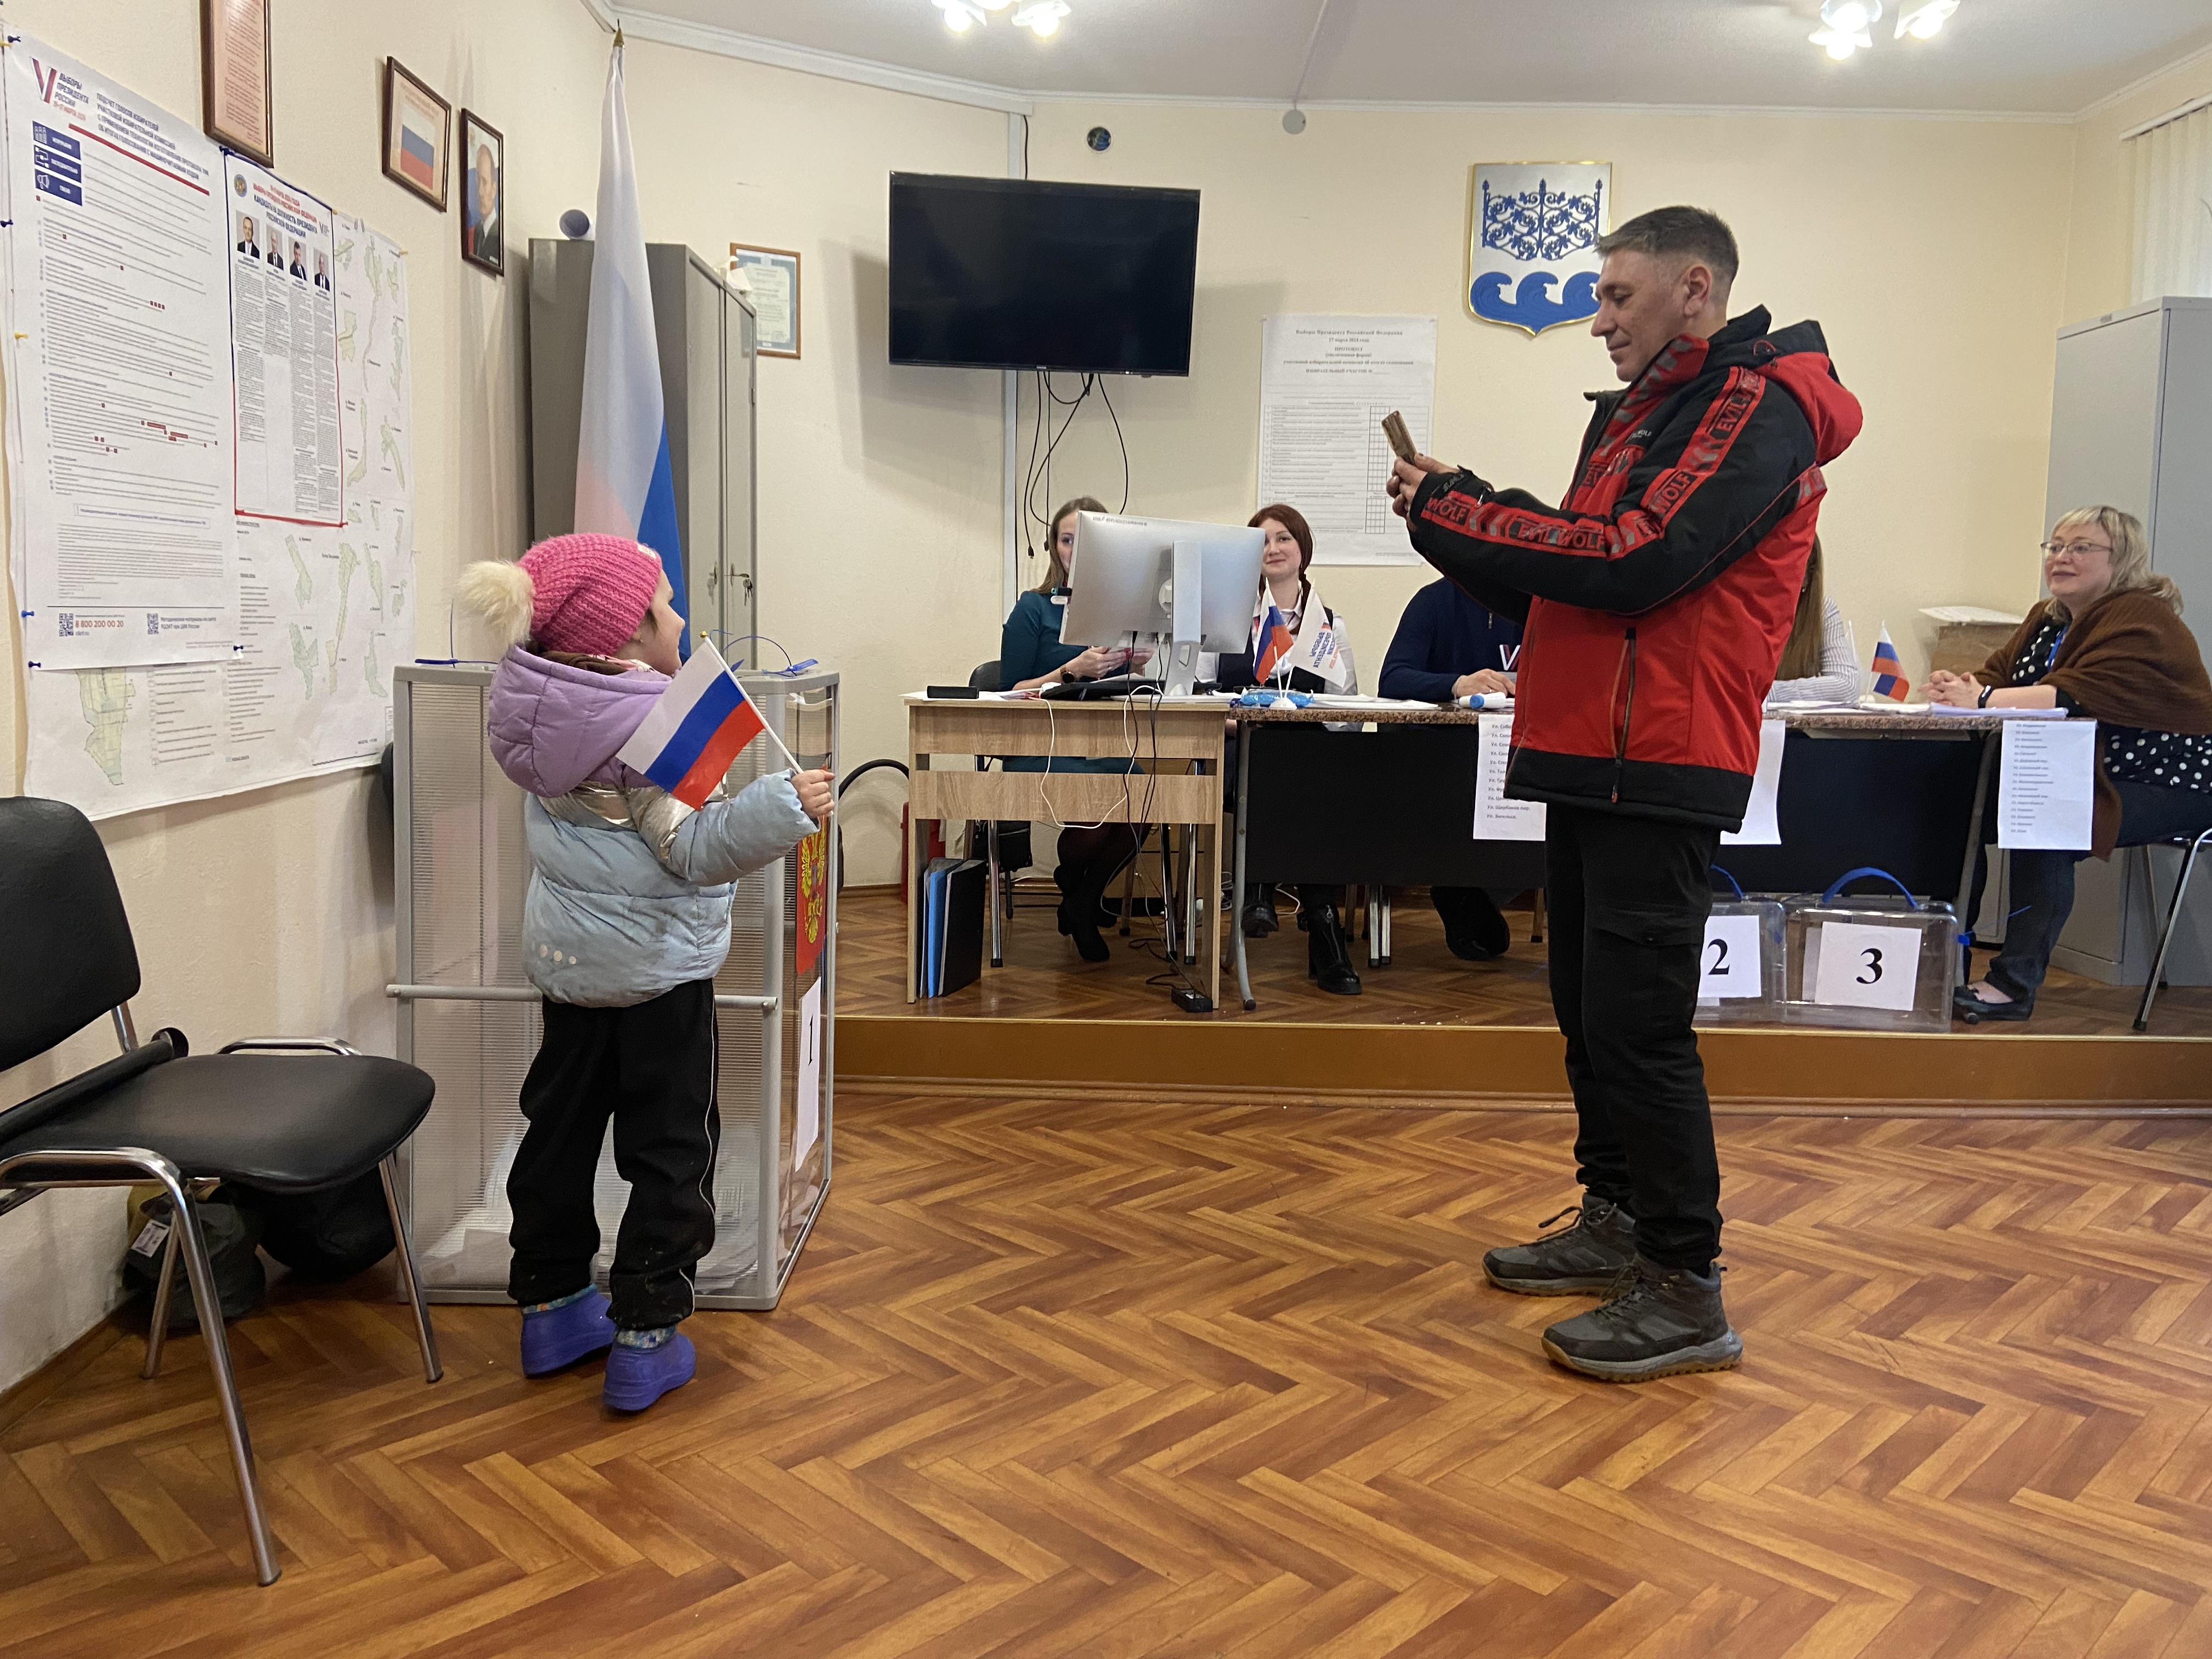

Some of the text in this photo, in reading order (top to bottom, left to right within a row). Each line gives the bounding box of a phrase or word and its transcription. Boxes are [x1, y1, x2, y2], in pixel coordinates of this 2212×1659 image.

[57, 82, 89, 104] ПРЕЗИДЕНТА
[59, 73, 82, 89] ВЫБОРЫ
[1427, 497, 1468, 522] WOLF
[1556, 531, 1605, 550] WOLF
[1707, 939, 1730, 975] 2
[1856, 947, 1883, 984] 3
[808, 1014, 813, 1066] 1
